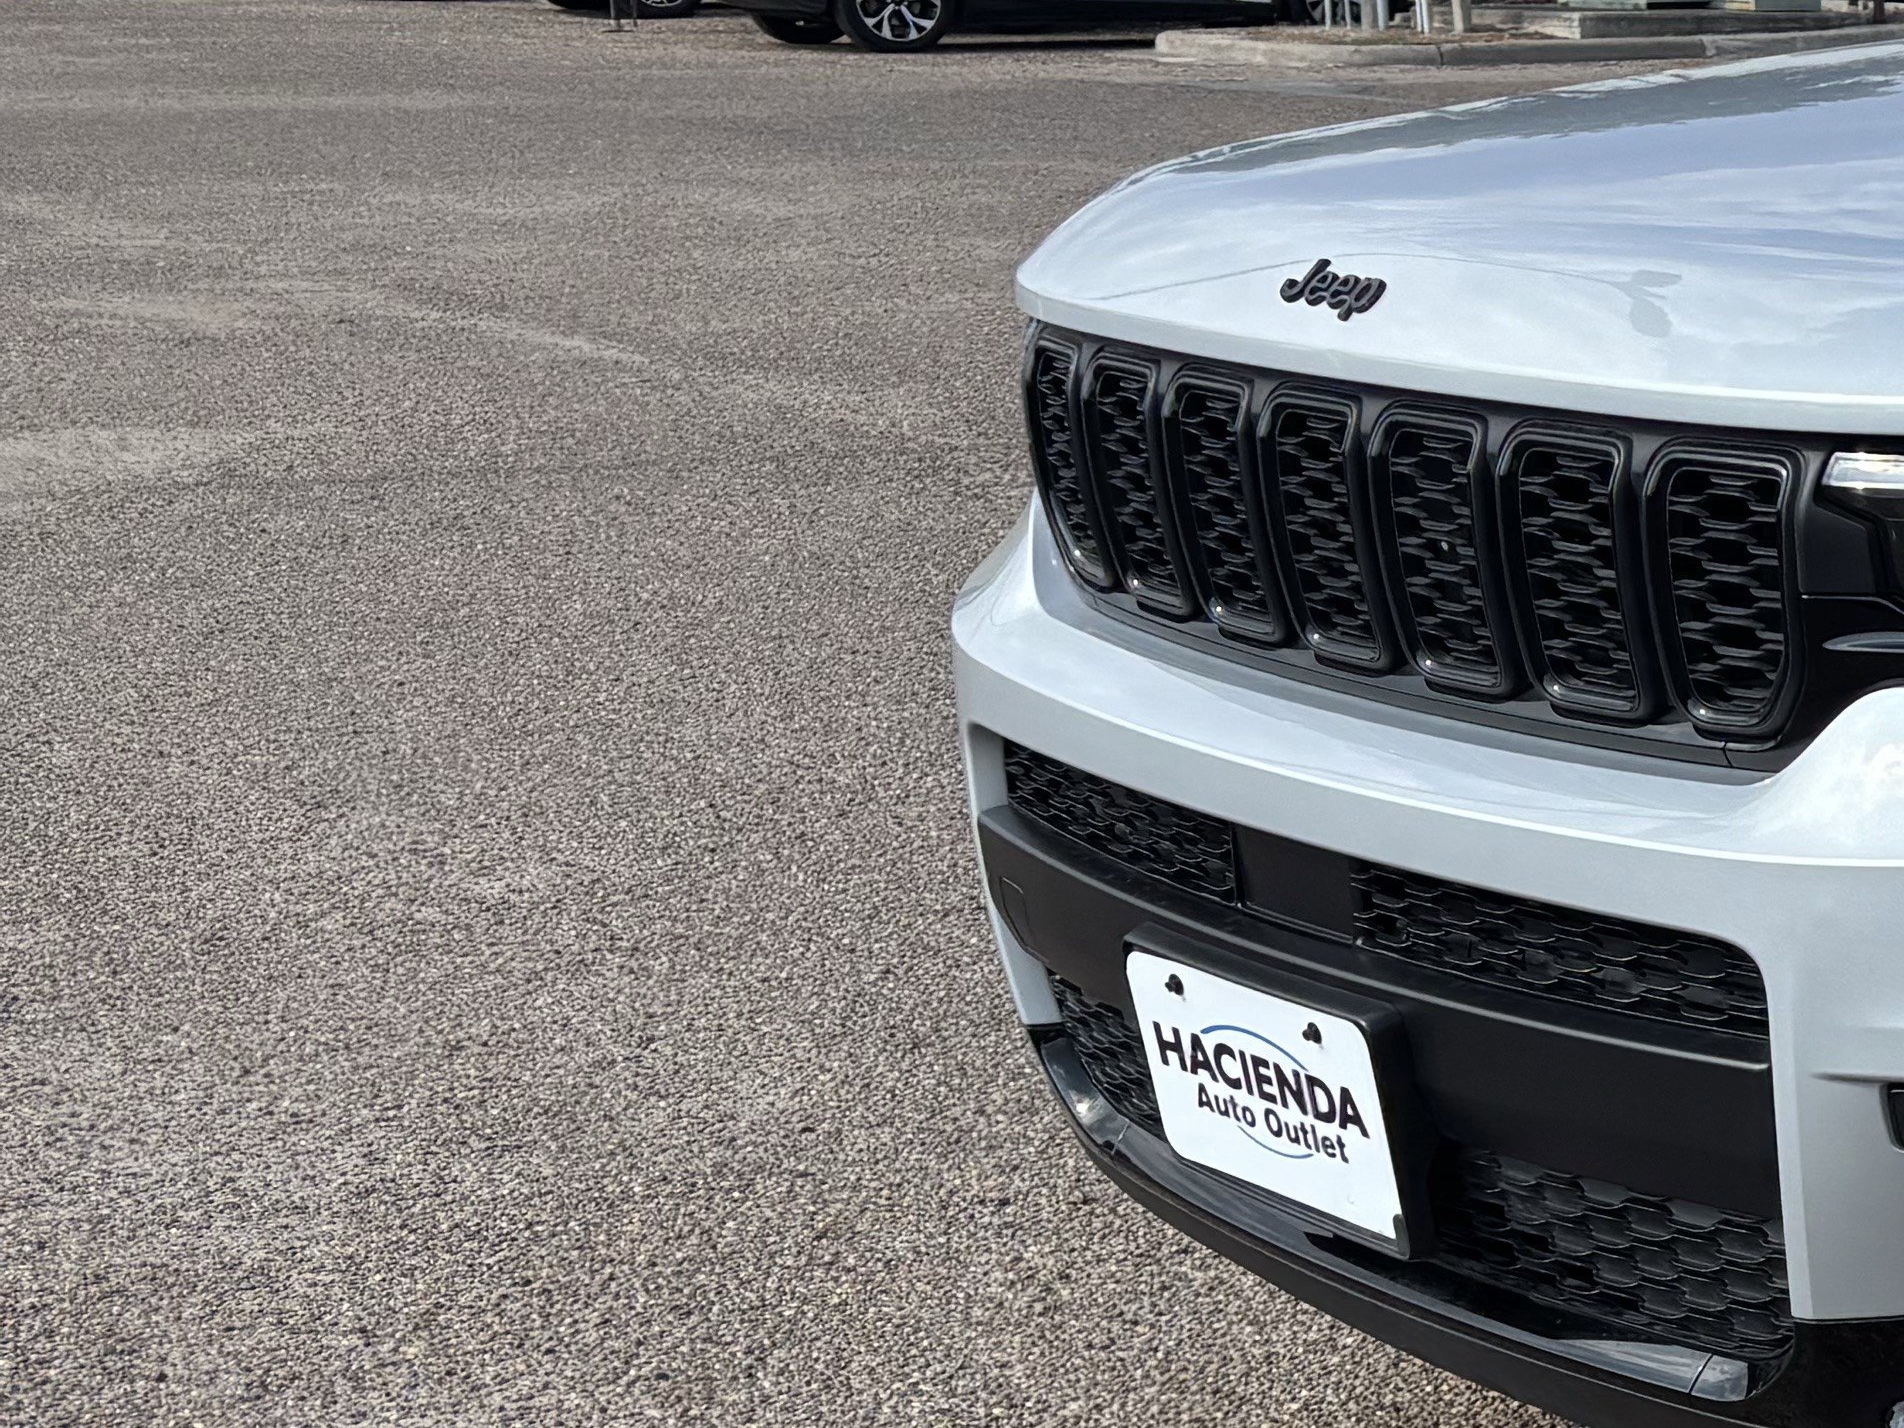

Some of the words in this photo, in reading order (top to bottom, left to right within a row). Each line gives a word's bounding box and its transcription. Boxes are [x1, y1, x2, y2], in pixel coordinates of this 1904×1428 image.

[1280, 258, 1387, 322] Jeep
[1152, 1020, 1371, 1140] HACIENDA
[1197, 1082, 1256, 1128] Auto
[1263, 1108, 1350, 1164] Outlet
